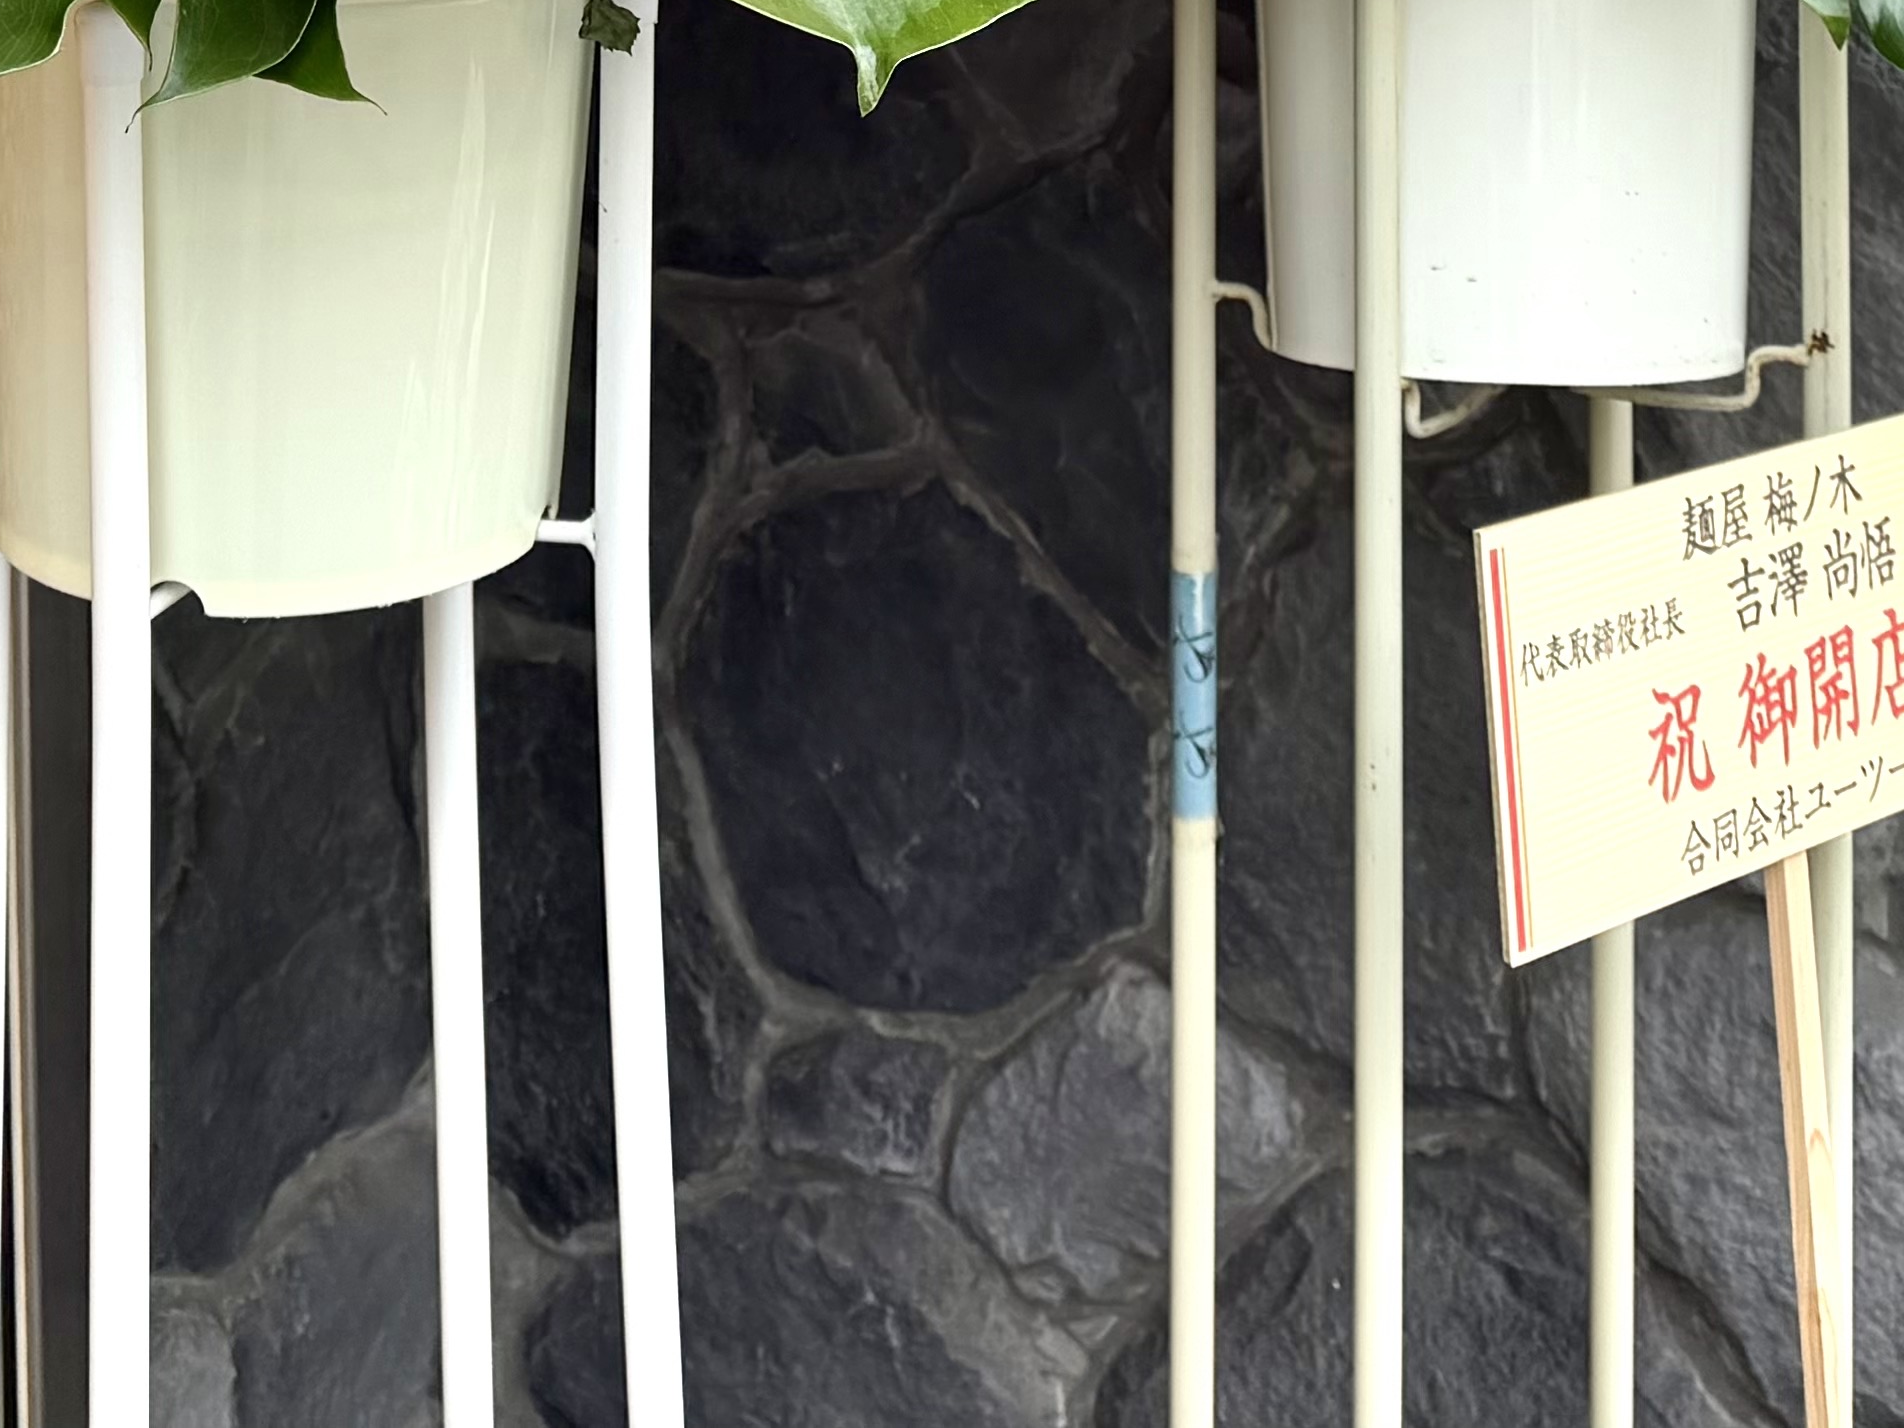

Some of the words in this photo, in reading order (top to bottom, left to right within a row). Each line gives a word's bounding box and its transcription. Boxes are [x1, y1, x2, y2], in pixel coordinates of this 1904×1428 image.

[1682, 482, 1753, 561] 麺屋
[1763, 453, 1863, 535] 梅ノ木
[1648, 683, 1717, 805] 祝
